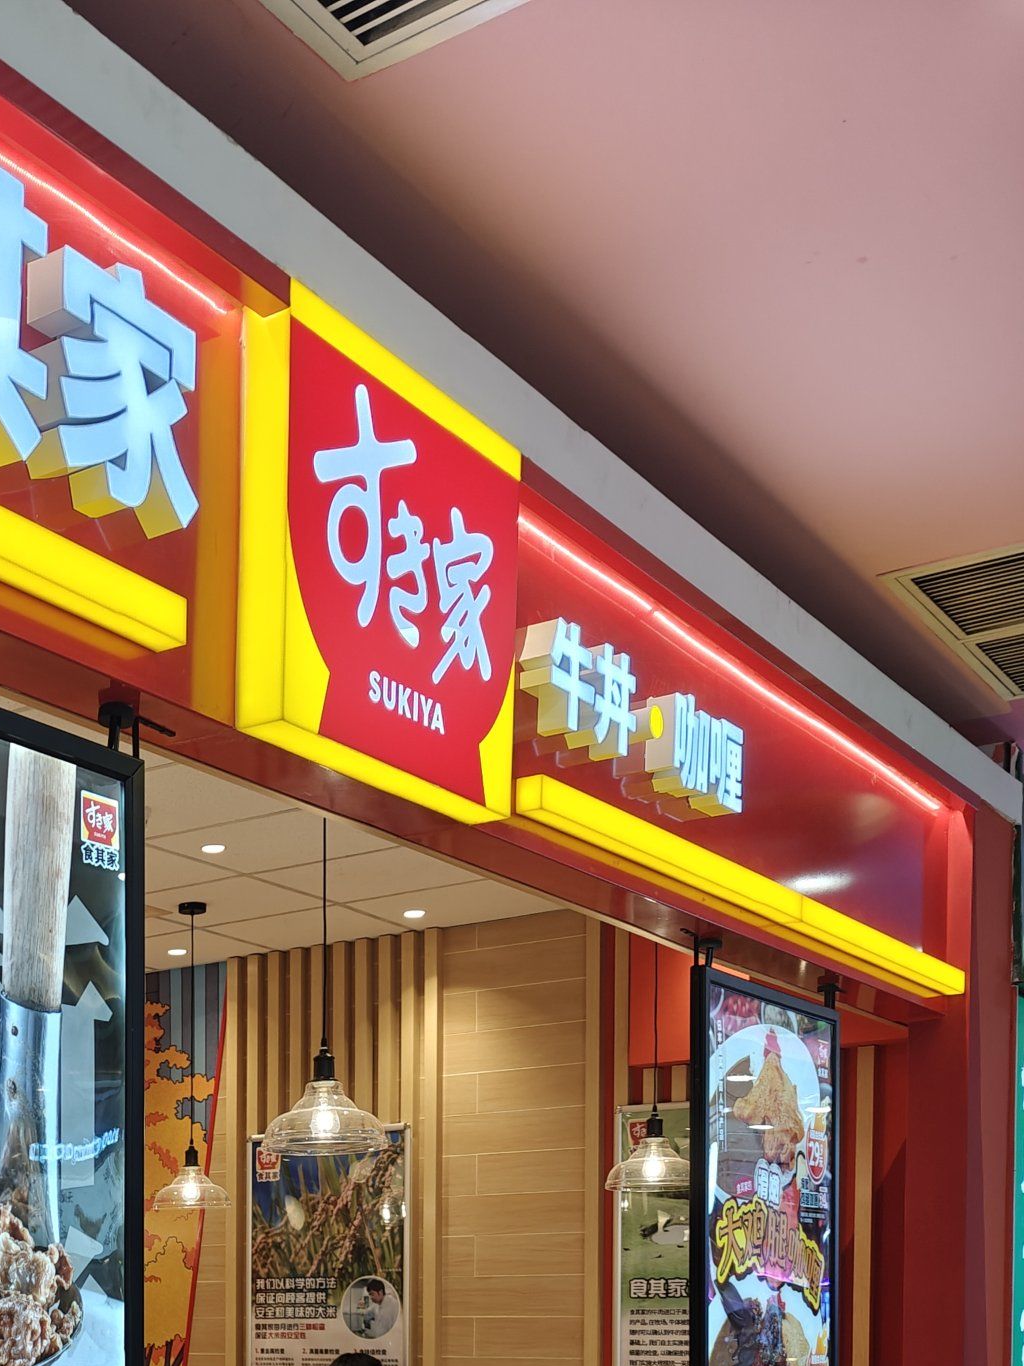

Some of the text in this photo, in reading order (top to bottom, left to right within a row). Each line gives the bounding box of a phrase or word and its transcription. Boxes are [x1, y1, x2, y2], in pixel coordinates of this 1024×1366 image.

[313, 384, 493, 685] すき家
[369, 670, 445, 736] SUKIYA
[85, 800, 113, 833] すき家
[82, 845, 118, 869] 食其家
[255, 1170, 281, 1182] 食其家
[255, 1277, 337, 1290] 我们以科学的方法
[629, 1277, 689, 1298] 食其家
[255, 1292, 327, 1305] 保证向顾客提供
[255, 1306, 337, 1319] 安全和美味的大米
